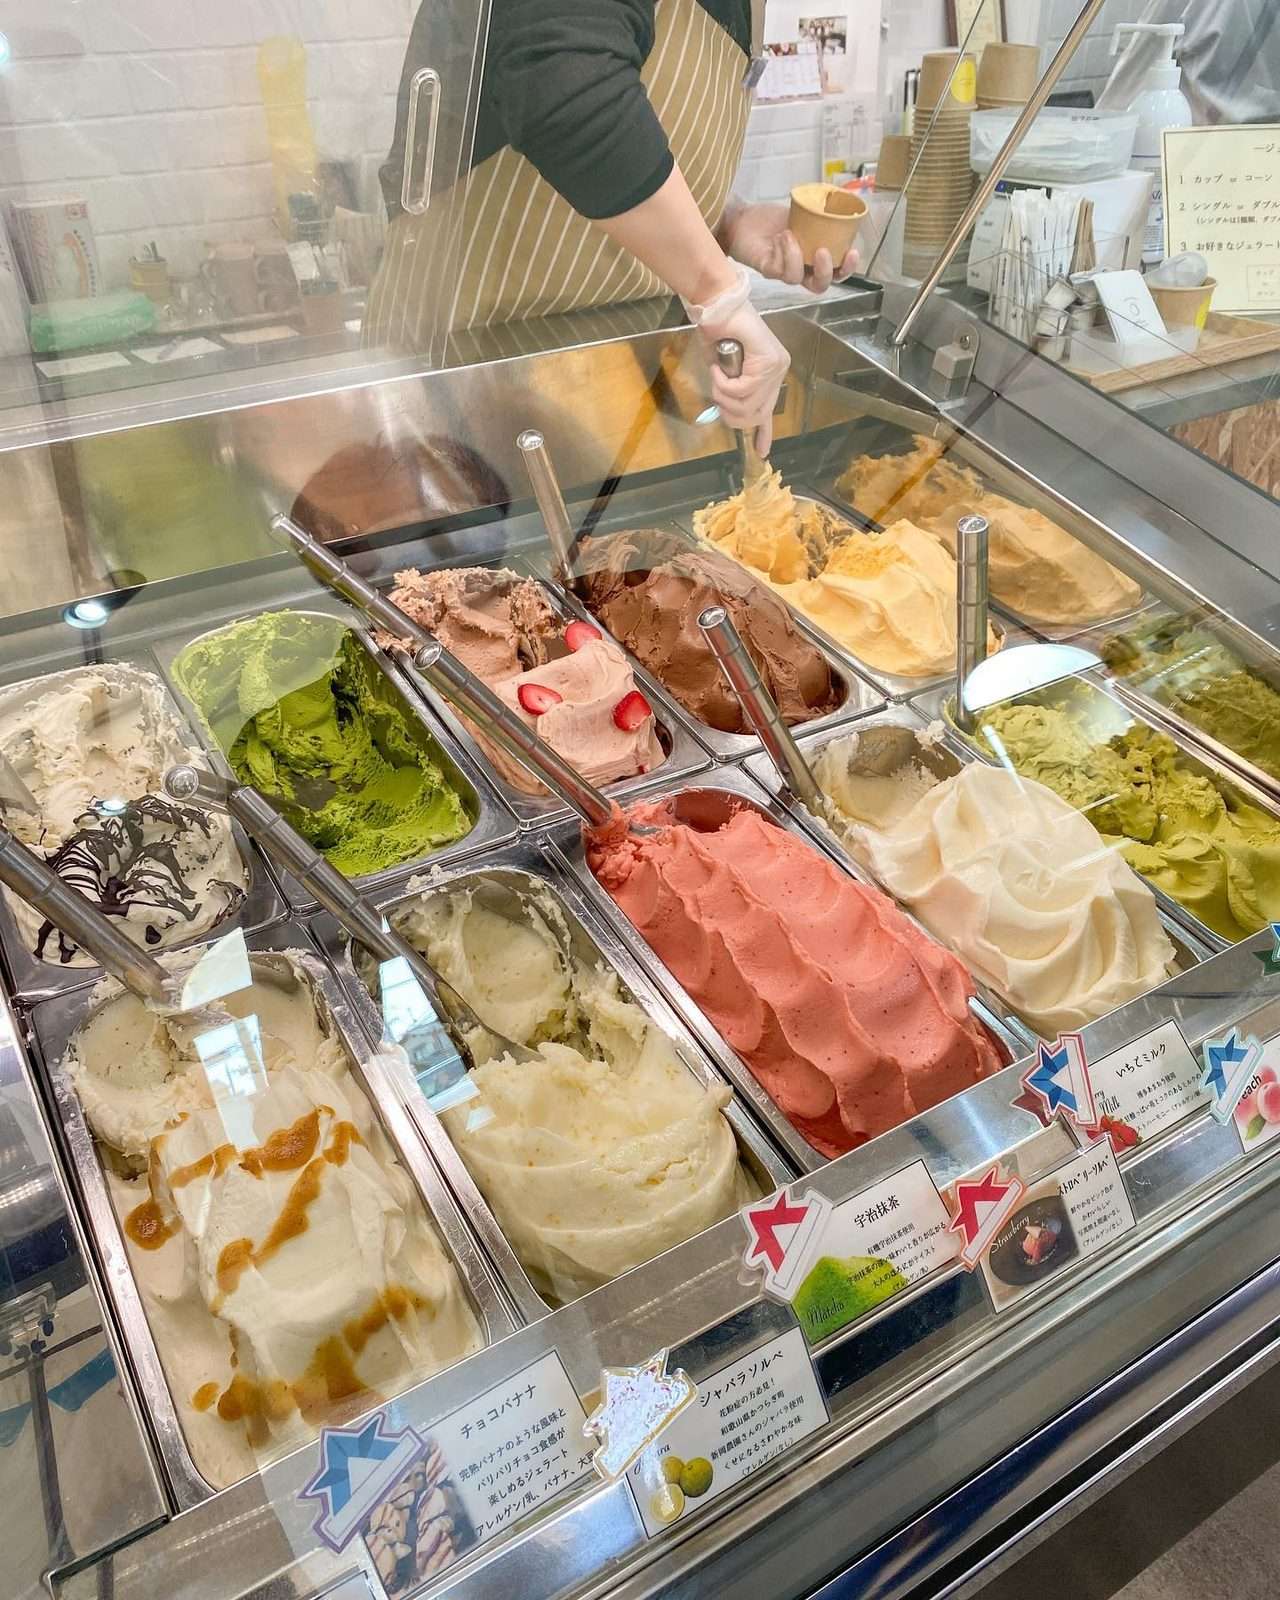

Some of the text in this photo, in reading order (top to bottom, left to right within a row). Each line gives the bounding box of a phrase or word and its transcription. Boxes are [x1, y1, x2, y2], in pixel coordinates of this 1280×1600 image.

[1179, 175, 1185, 185] 1
[1193, 173, 1223, 184] カップ
[1245, 174, 1273, 183] コーン
[1179, 202, 1185, 211] 2
[1192, 201, 1231, 211] シングル
[1252, 201, 1280, 210] ダブル
[1180, 241, 1187, 252] 3
[1098, 1095, 1121, 1116] Milk
[854, 1194, 901, 1229] 宇治抹茶
[990, 1215, 1030, 1254] Strawberry
[806, 1297, 846, 1328] Matcha
[460, 1383, 537, 1440] チョコバナナ
[458, 1407, 567, 1482] 完熟バナナのような風味と
[487, 1448, 568, 1507] 楽しめるジェラート
